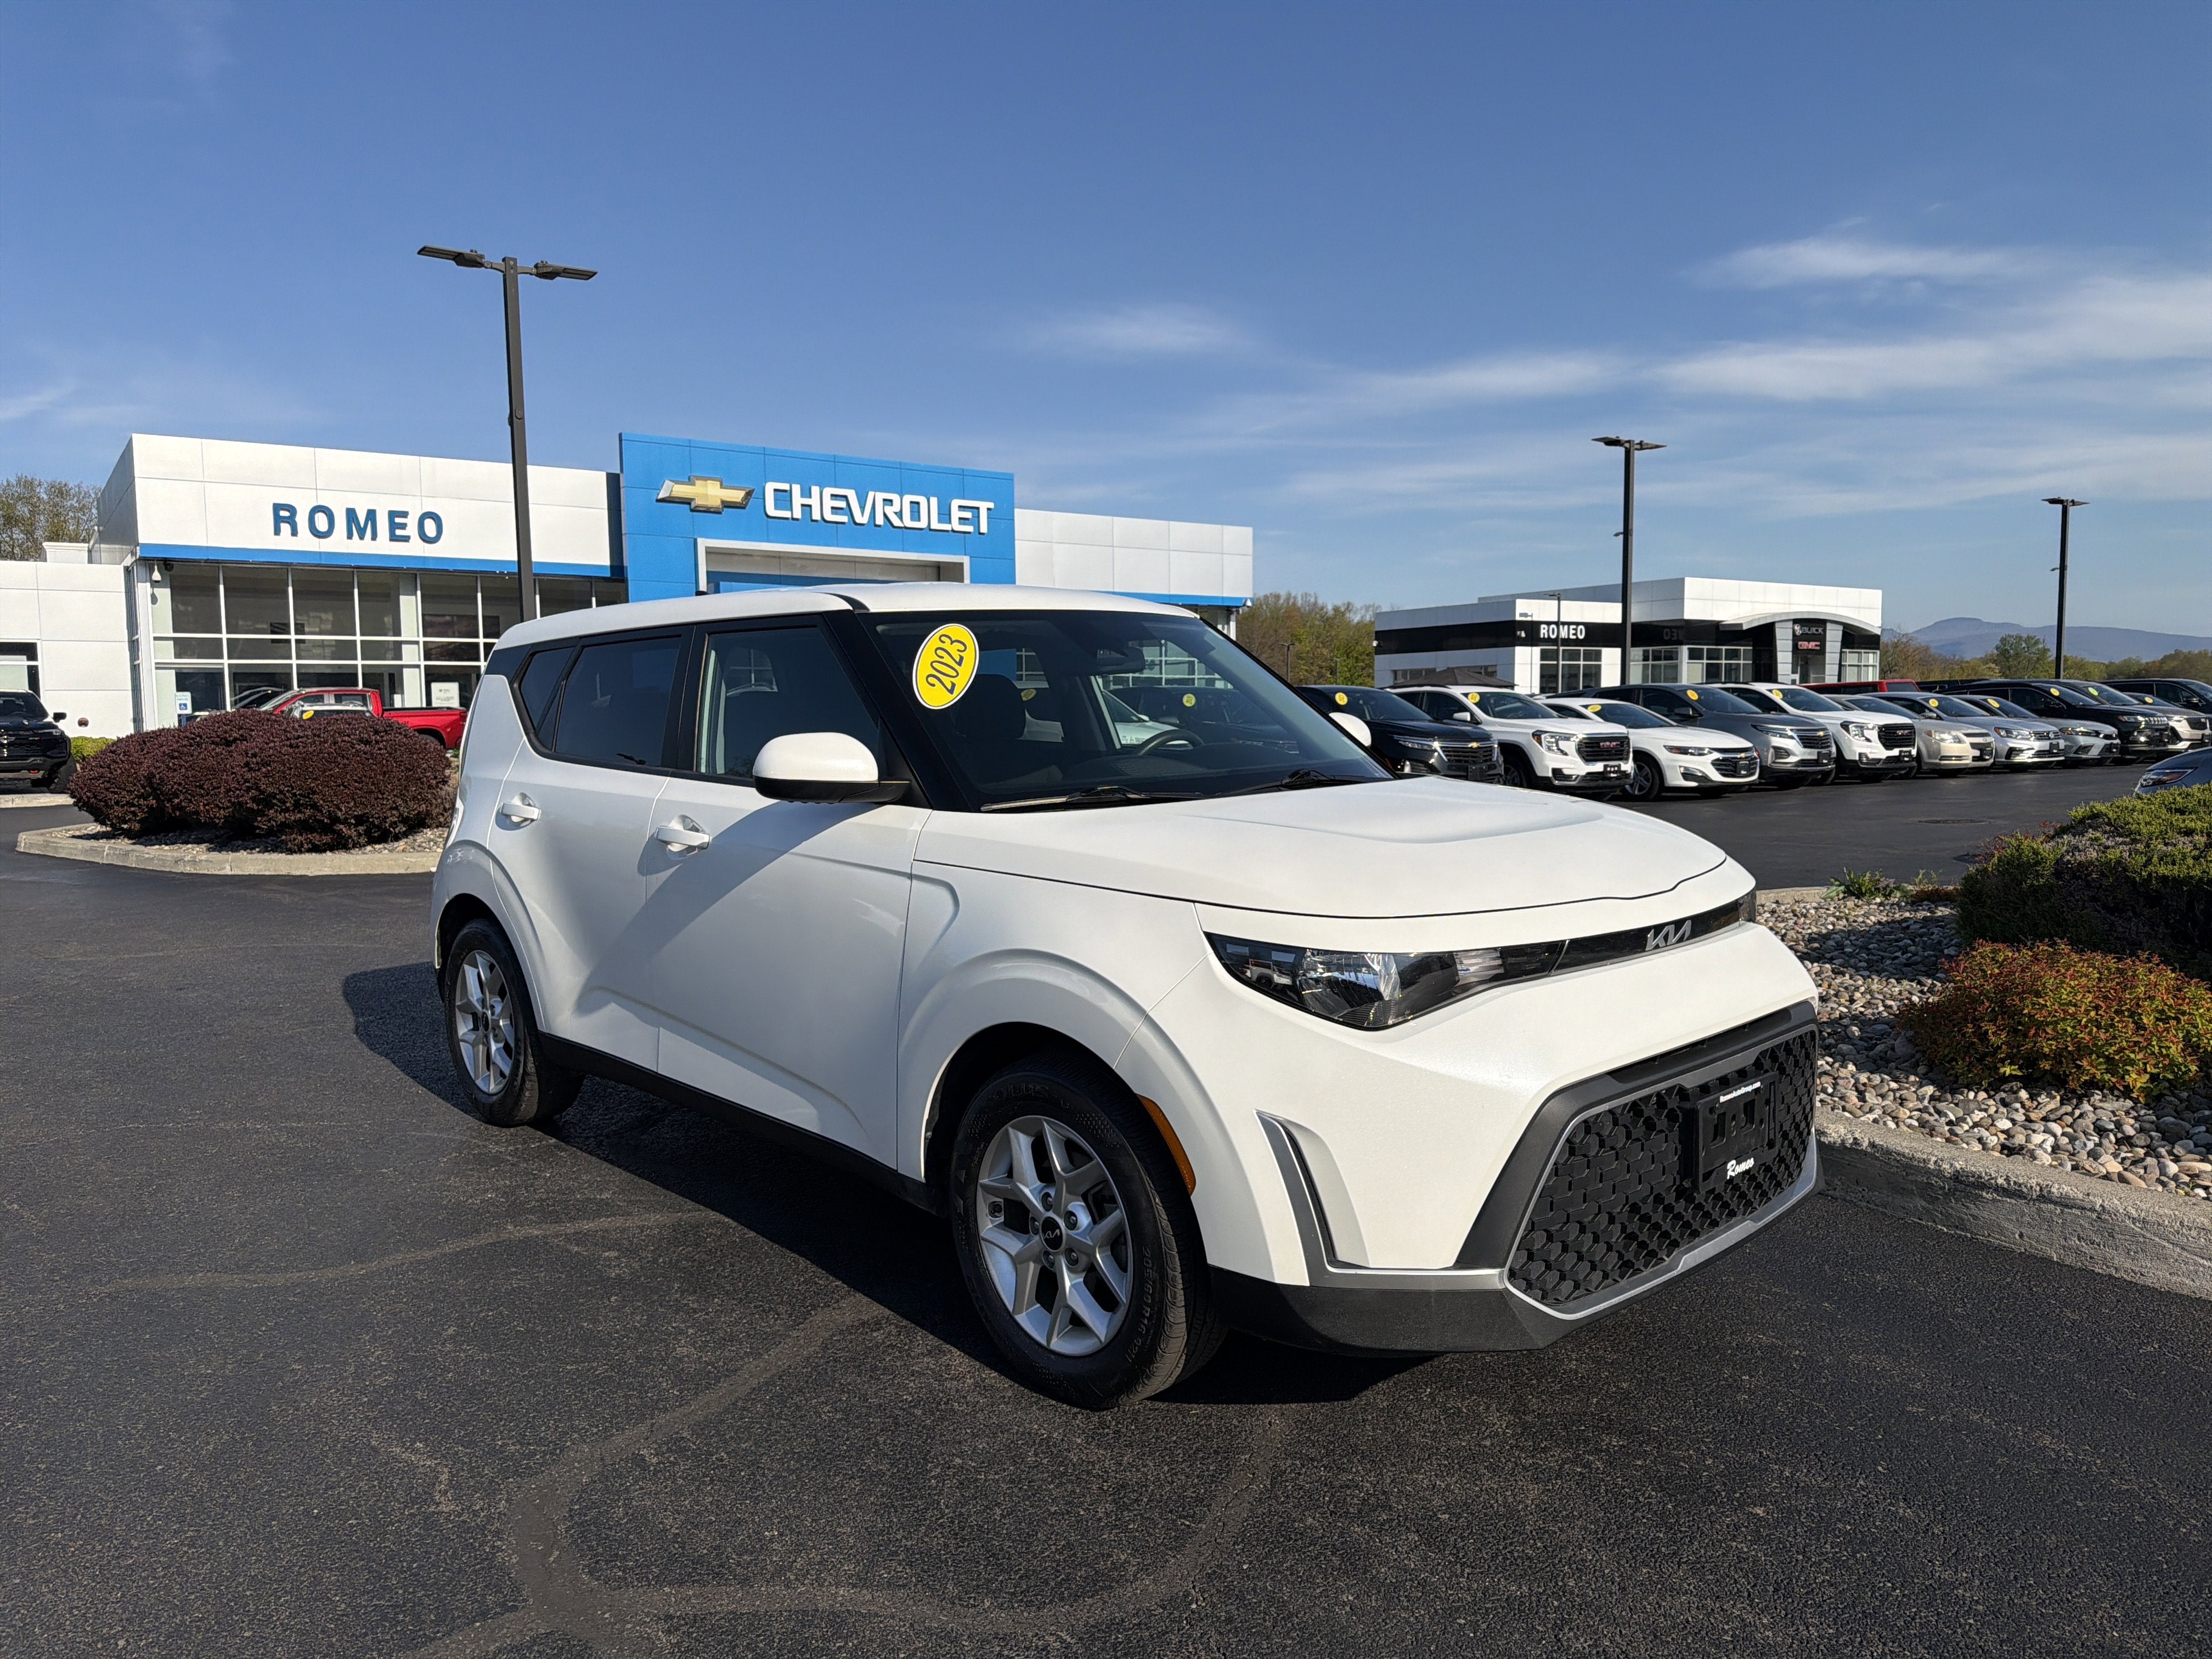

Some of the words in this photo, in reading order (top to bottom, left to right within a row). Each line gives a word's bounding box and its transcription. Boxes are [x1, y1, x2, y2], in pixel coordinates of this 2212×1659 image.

[272, 502, 443, 545] ROMEO
[764, 481, 995, 534] CHEVROLET
[1539, 624, 1585, 639] ROMEO
[1798, 641, 1820, 650] GMC
[926, 634, 967, 696] 2023
[1645, 919, 1692, 951] KIA
[1726, 1157, 1755, 1180] Romeo
